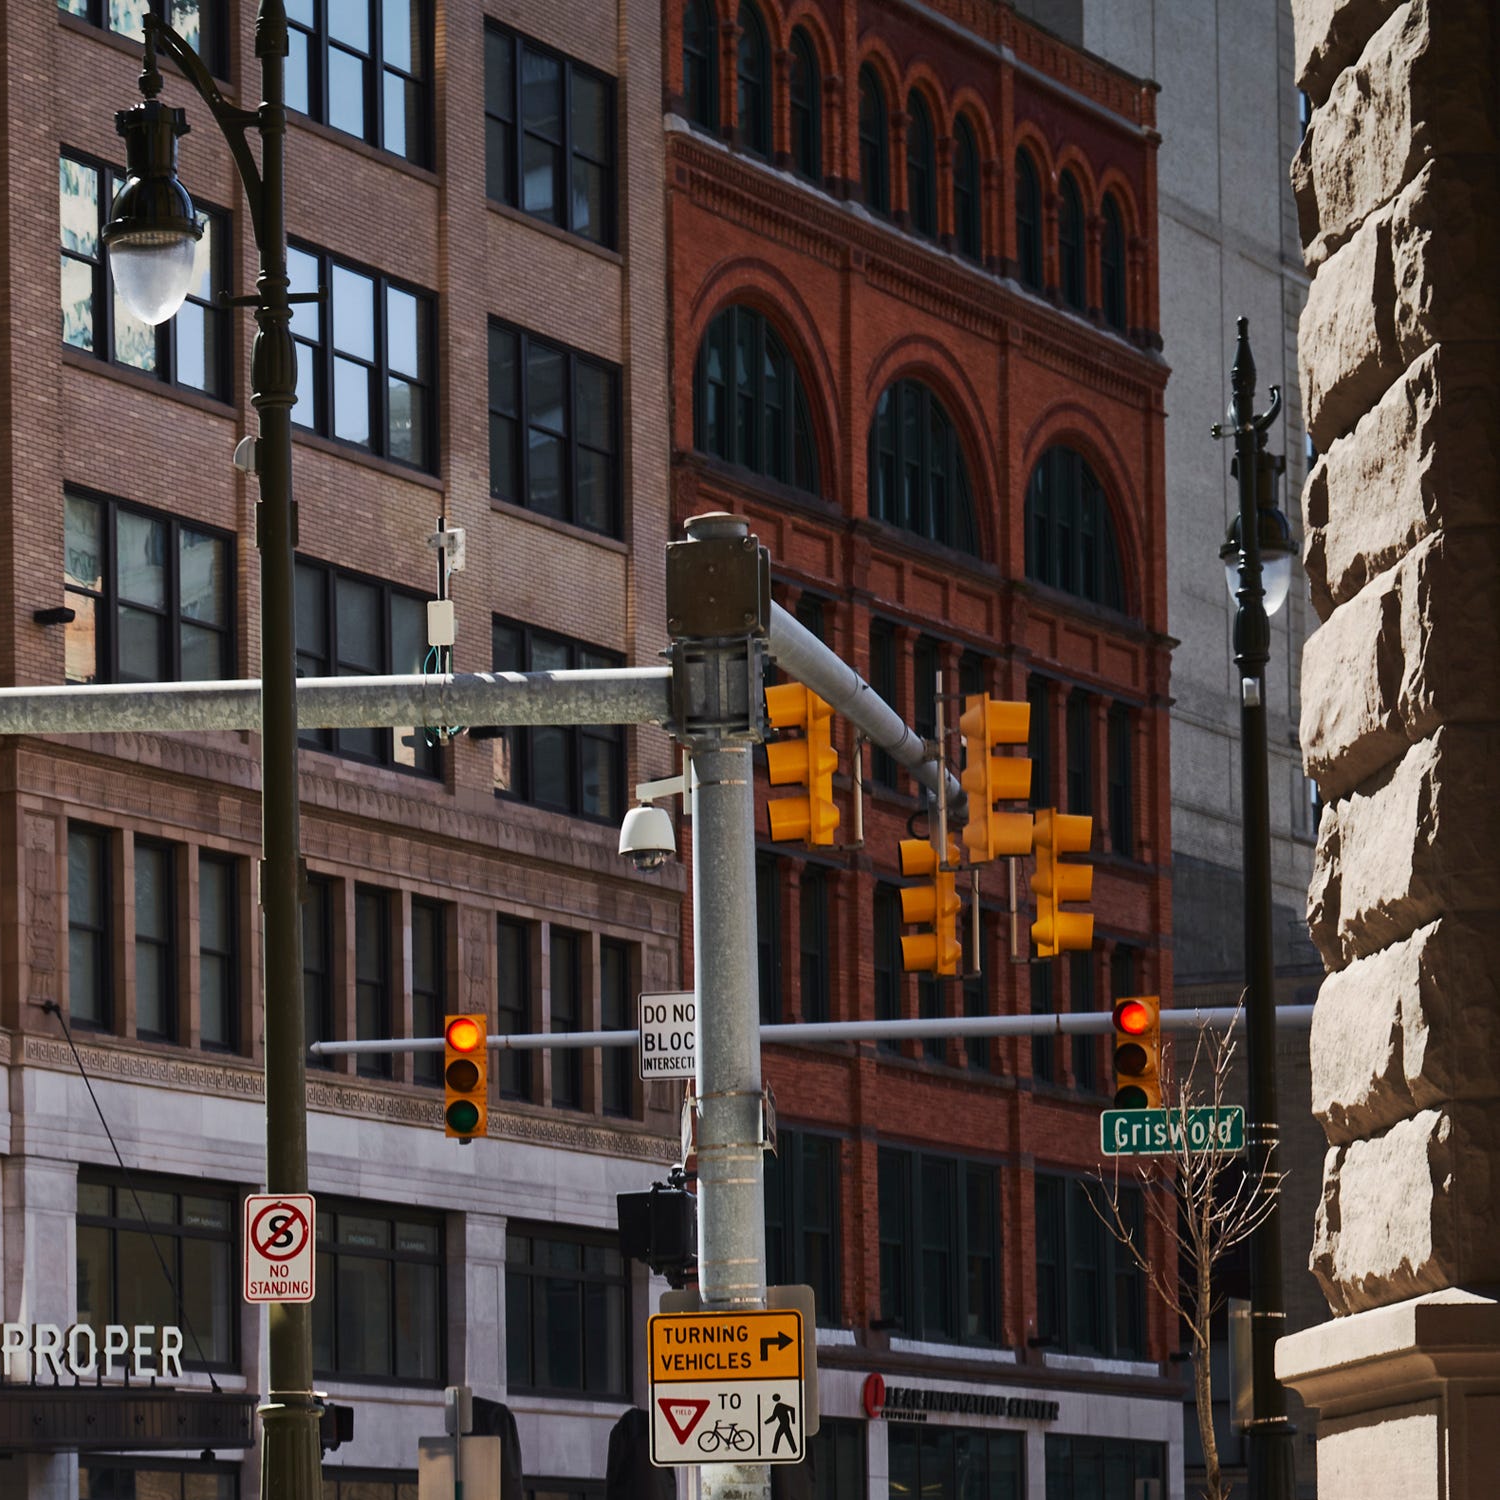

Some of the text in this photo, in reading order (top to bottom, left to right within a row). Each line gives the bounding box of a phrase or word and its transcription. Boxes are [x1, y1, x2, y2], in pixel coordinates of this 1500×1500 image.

[644, 1005, 667, 1024] DO
[270, 1264, 289, 1278] NO
[250, 1281, 309, 1295] STANDING
[664, 1325, 748, 1344] TURNING
[0, 1323, 184, 1379] PROPER
[661, 1352, 752, 1371] VEHICLES
[718, 1393, 741, 1410] TO
[924, 1389, 1006, 1416] INNOVATION
[1007, 1396, 1060, 1421] CENTER
[675, 1408, 692, 1416] YIELD
